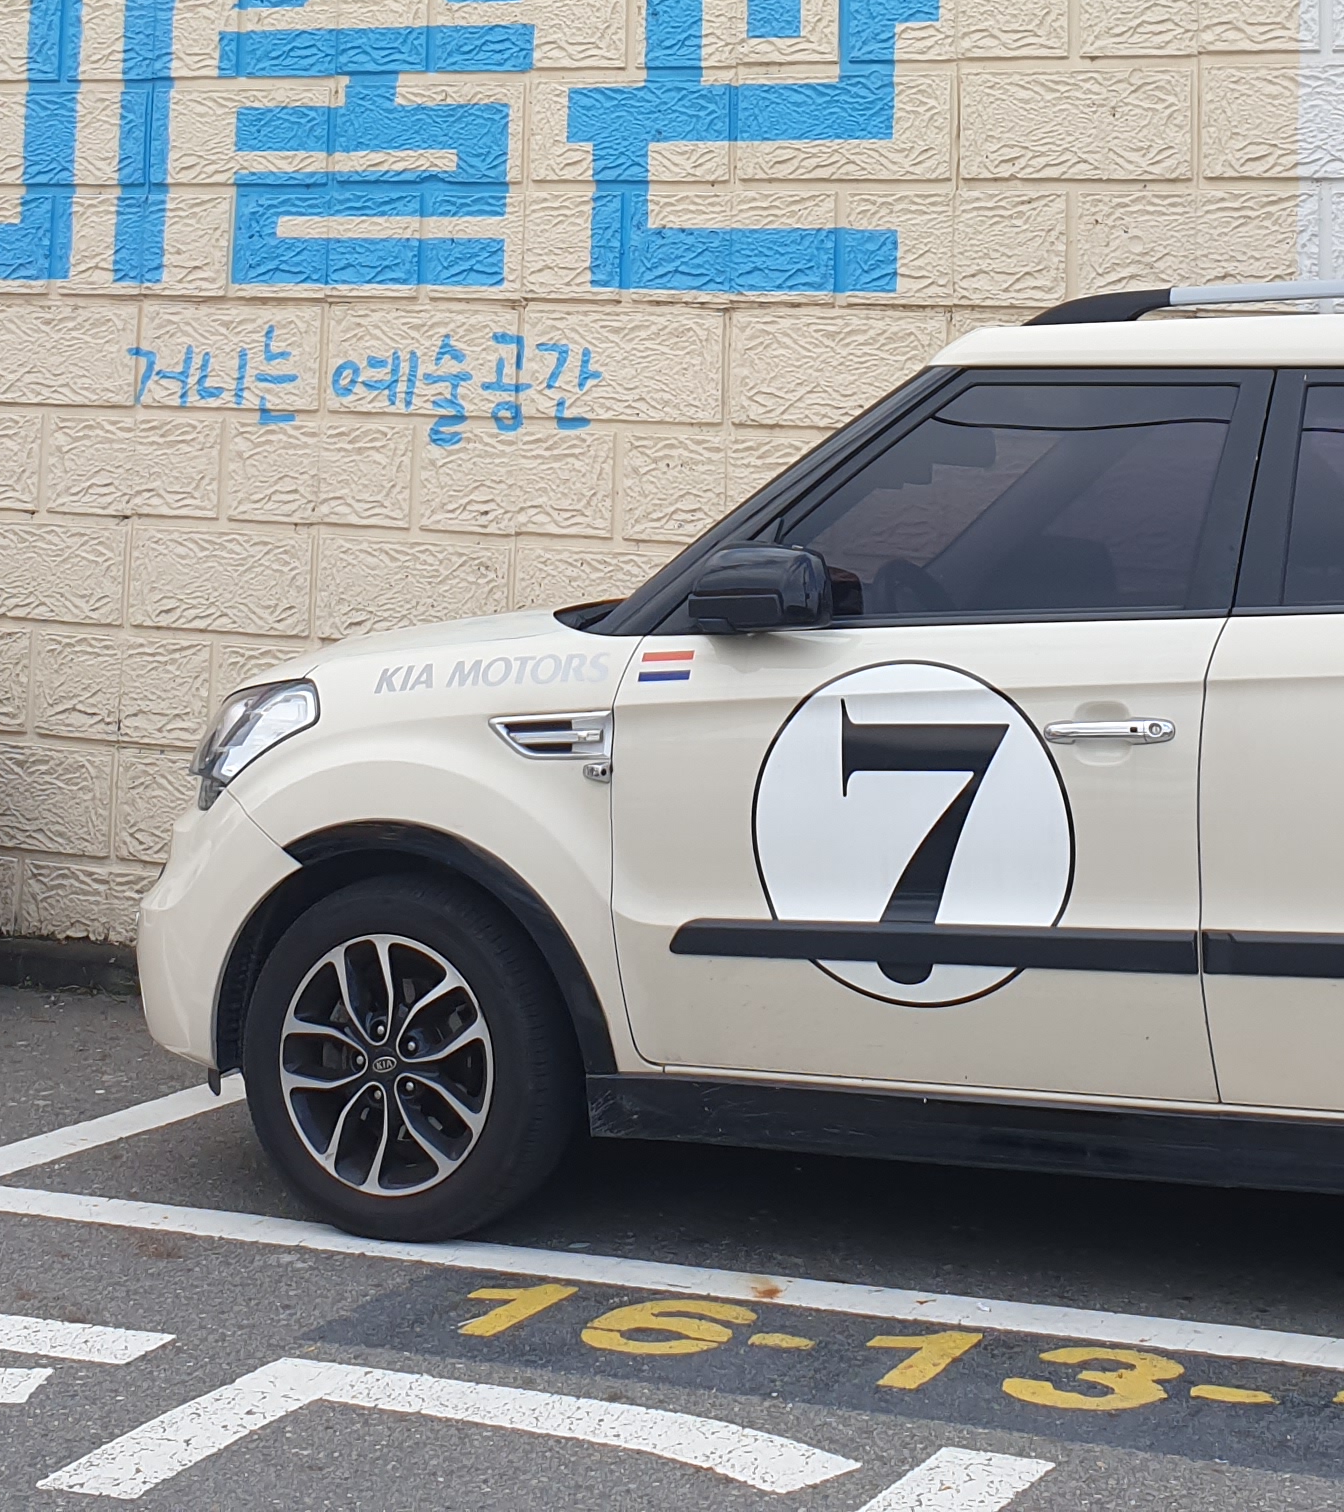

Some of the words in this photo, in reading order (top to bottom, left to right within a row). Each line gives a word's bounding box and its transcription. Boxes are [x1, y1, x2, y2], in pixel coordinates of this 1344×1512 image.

[126, 324, 299, 426] 거니는
[373, 663, 434, 695] KIA
[445, 651, 611, 688] MOTORS
[840, 697, 1010, 985] 7
